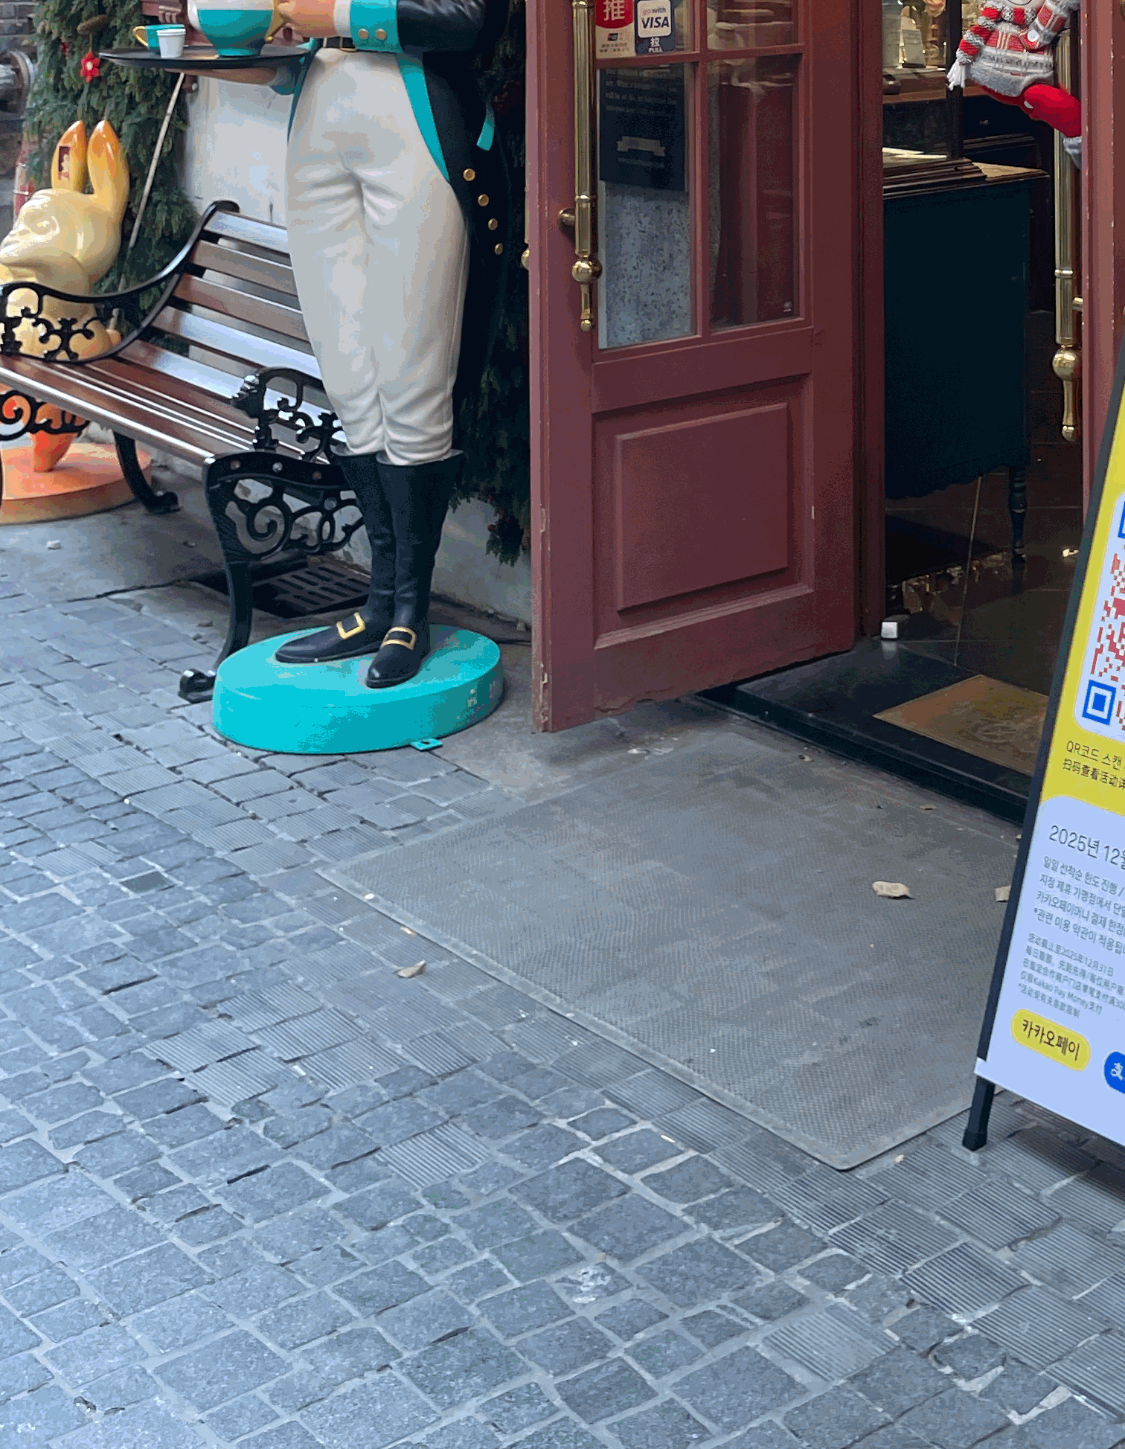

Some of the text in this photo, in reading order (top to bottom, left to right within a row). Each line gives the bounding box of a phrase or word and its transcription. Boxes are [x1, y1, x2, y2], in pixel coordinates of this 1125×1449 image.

[641, 16, 670, 29] VISA
[1066, 740, 1100, 761] QR코드
[1101, 753, 1123, 770] 스캔
[1049, 824, 1101, 859] 2025년
[1023, 1018, 1081, 1061] 카카오페이
